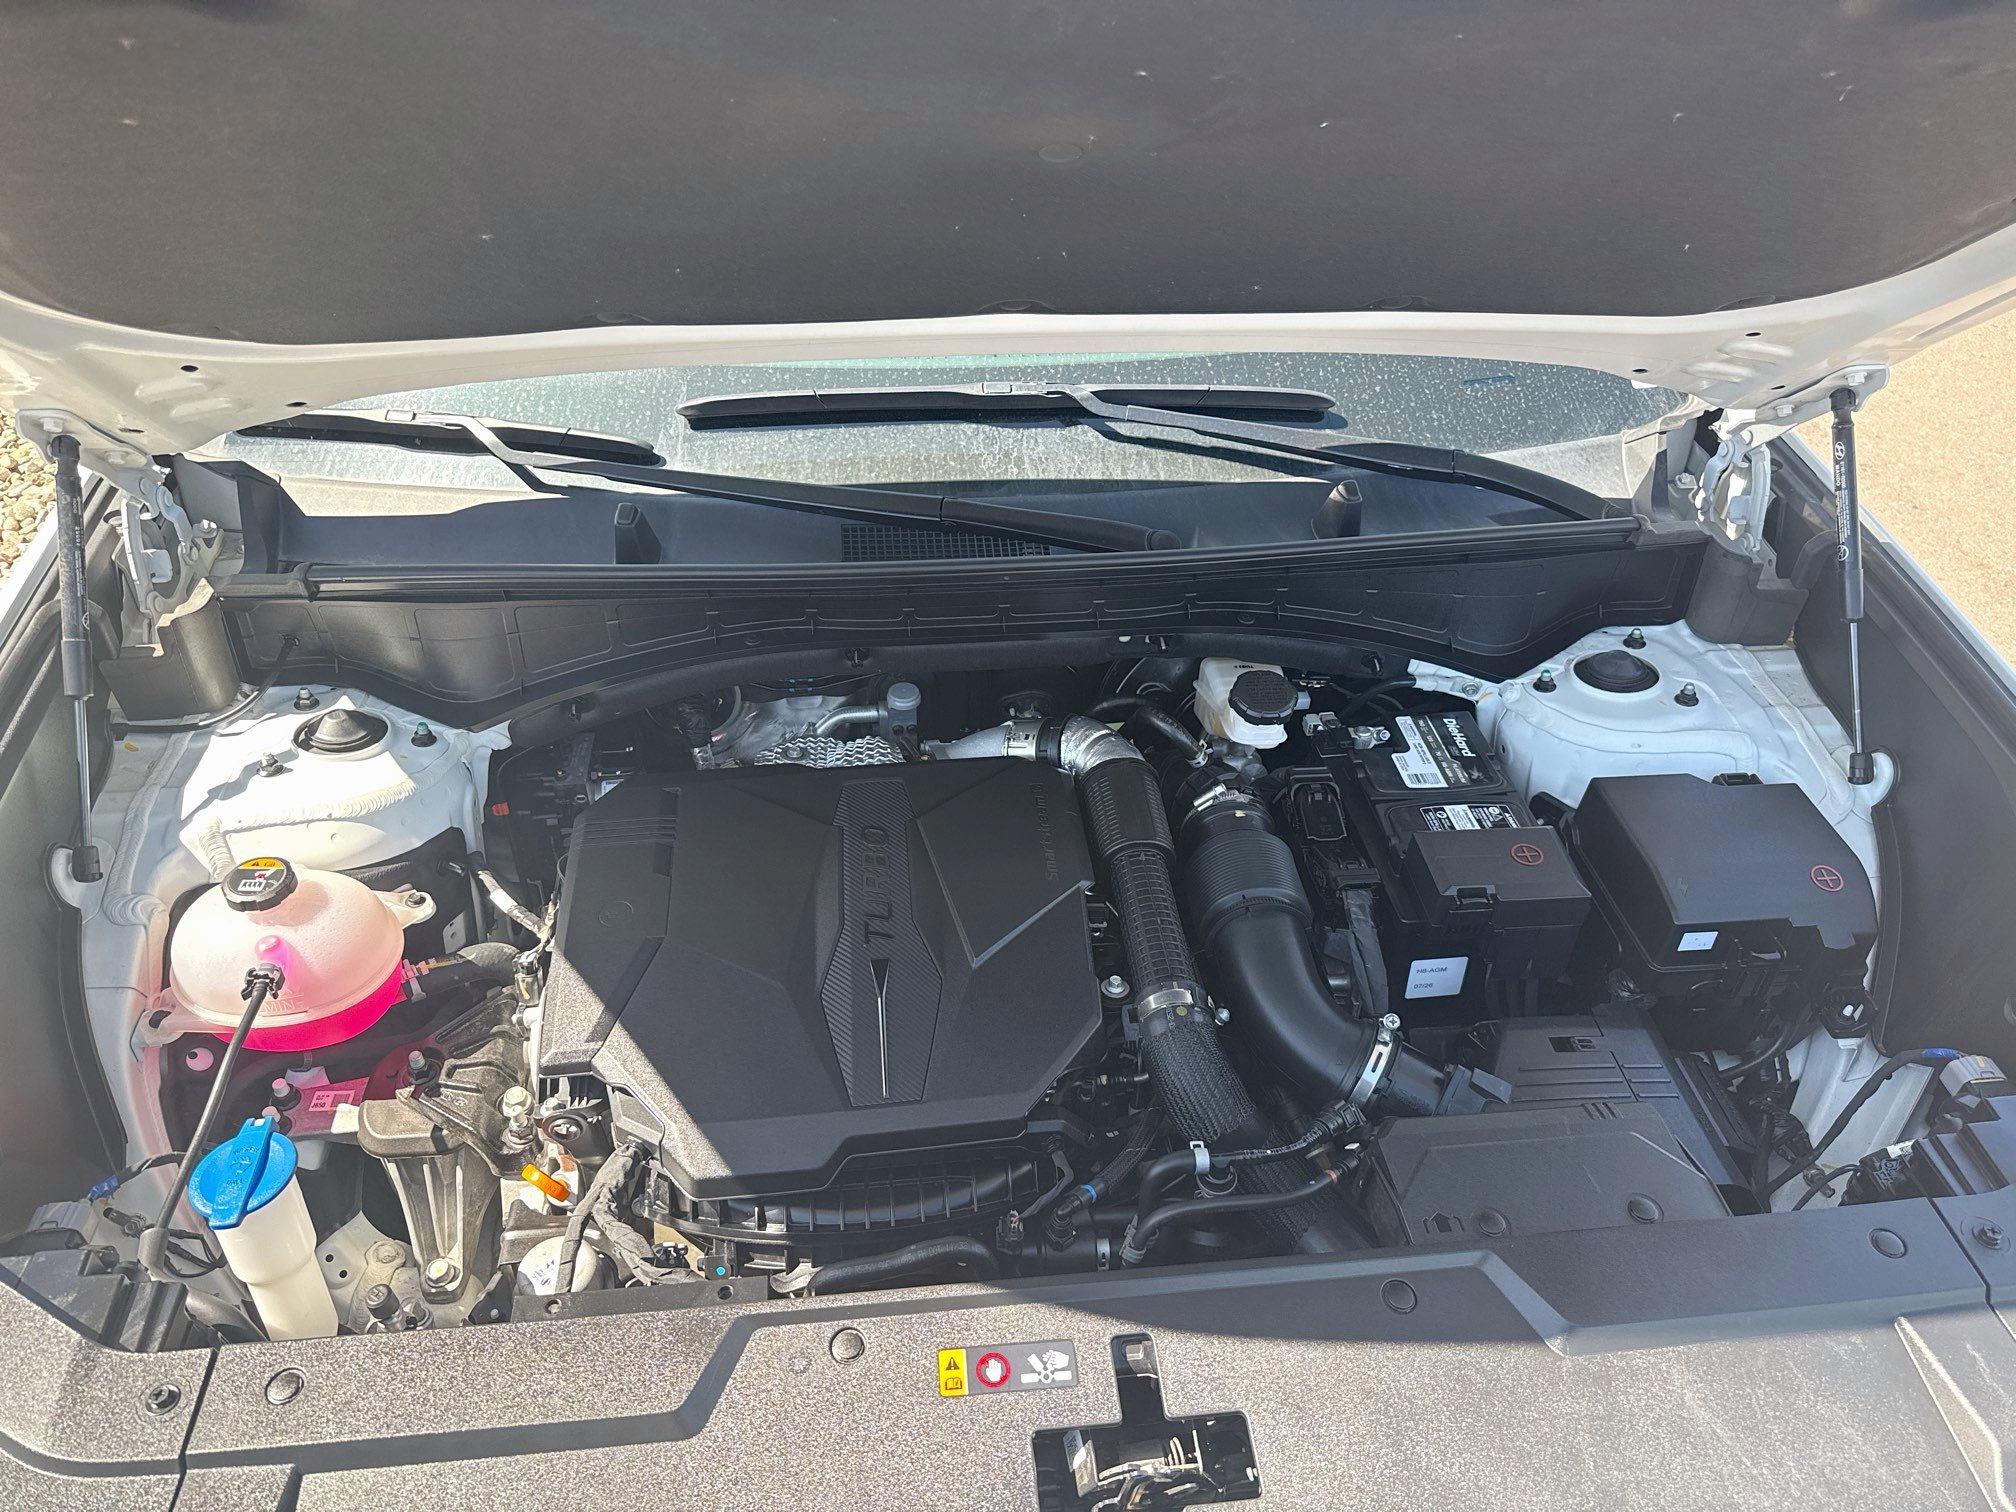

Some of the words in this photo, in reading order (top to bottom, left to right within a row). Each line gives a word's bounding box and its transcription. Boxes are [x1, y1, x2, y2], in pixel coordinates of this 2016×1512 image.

[1443, 718, 1477, 757] DieHard
[862, 826, 894, 944] TURBO
[263, 999, 296, 1014] MIN
